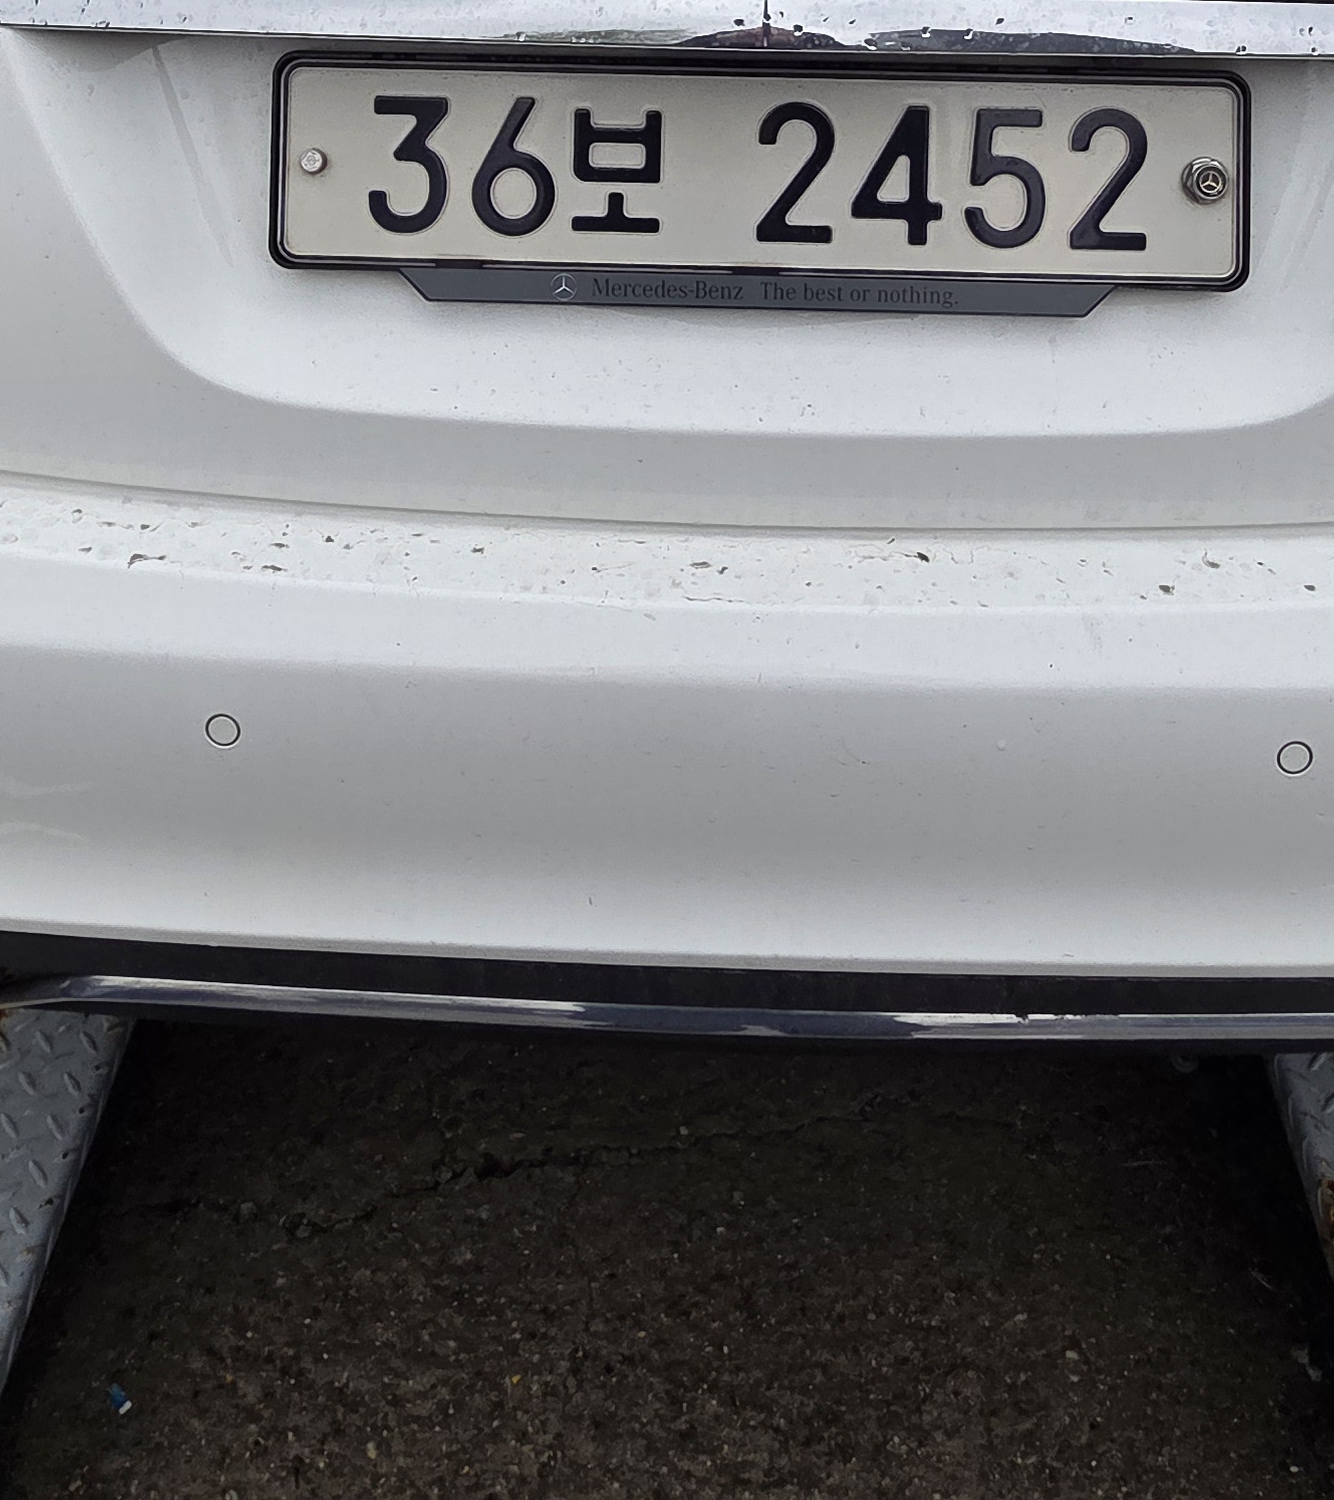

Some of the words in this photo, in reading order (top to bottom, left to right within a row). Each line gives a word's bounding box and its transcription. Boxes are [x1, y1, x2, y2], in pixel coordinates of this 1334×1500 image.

[368, 95, 662, 237] 36보
[756, 101, 1149, 252] 2452
[592, 277, 744, 300] Mercedes-Benz
[760, 281, 796, 301] The
[803, 283, 845, 303] best
[850, 289, 871, 303] or
[877, 285, 959, 308] nothing.
